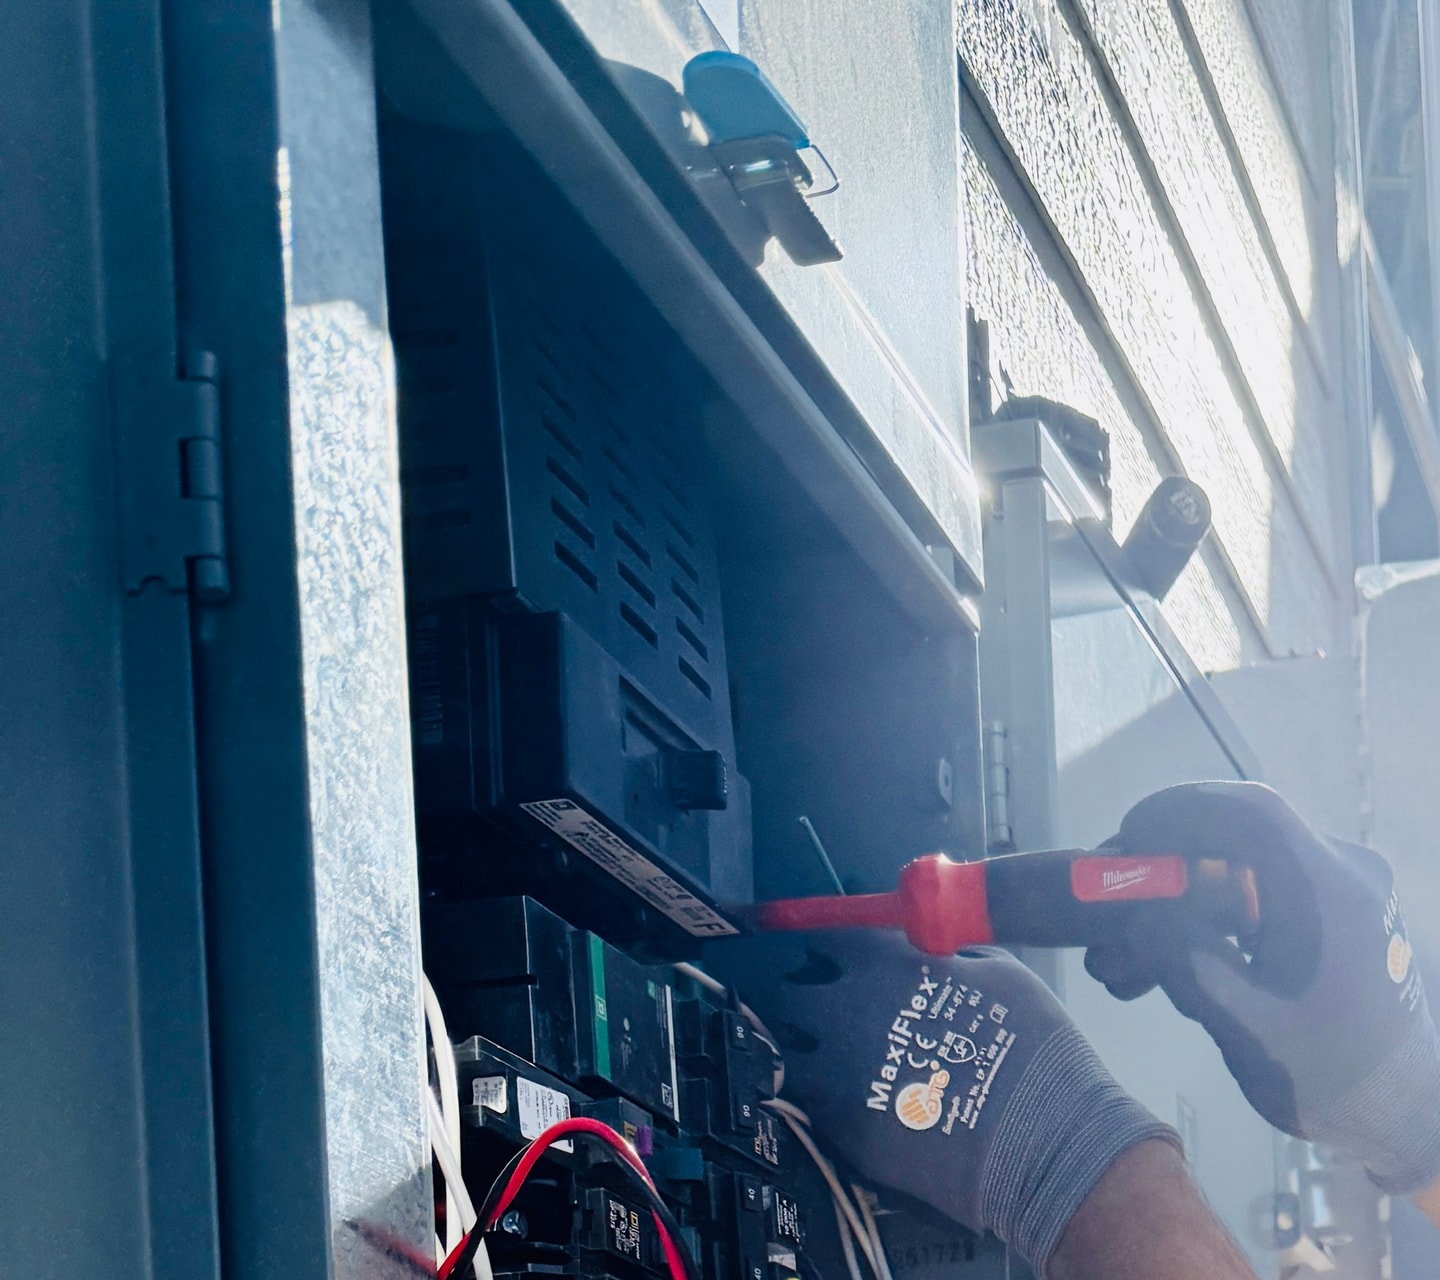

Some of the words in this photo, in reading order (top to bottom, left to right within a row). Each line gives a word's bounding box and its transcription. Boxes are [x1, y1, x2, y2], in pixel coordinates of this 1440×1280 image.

[866, 975, 939, 1112] MaxiFlex
[907, 1033, 937, 1068] CE
[748, 1188, 756, 1201] 40
[754, 1268, 762, 1280] 40
